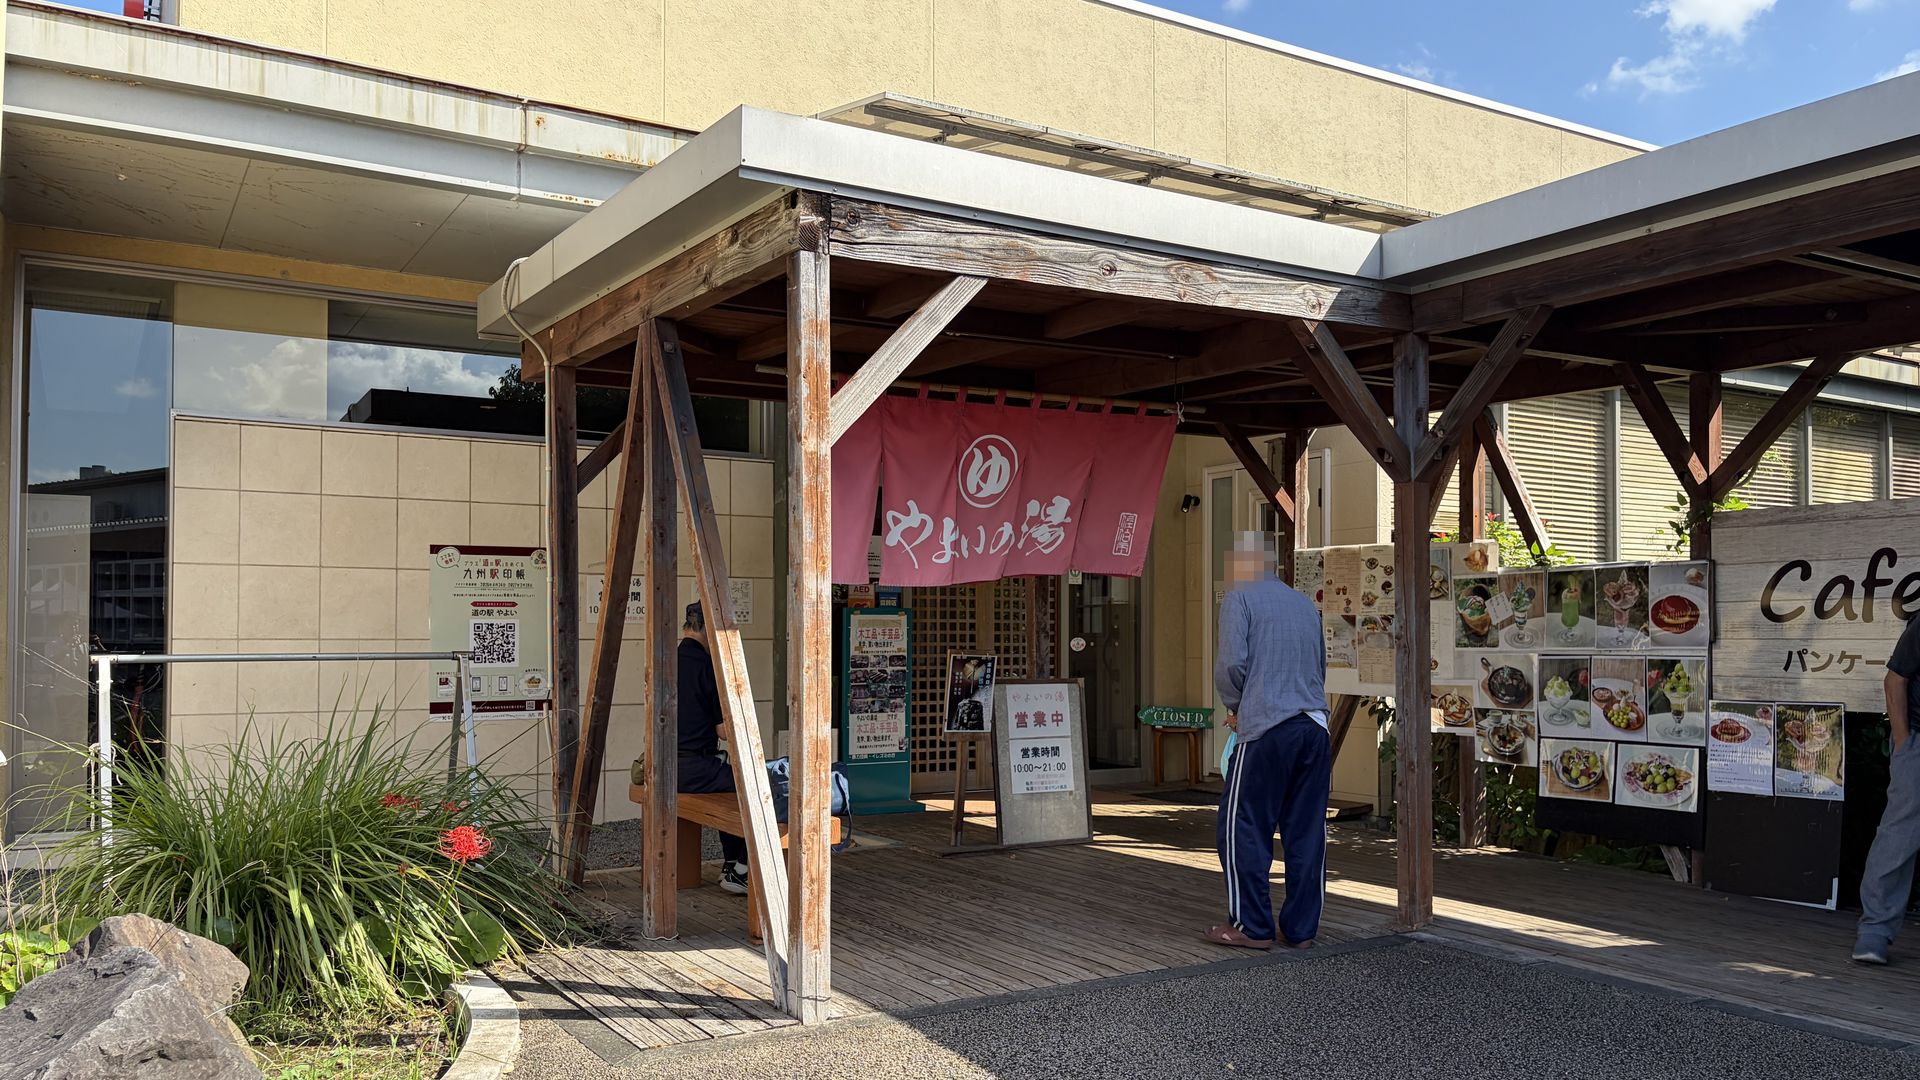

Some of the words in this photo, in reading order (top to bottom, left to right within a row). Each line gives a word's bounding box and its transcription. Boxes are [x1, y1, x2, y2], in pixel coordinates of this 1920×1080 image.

[966, 444, 1011, 498] ゆ
[885, 495, 1072, 569] やよいの湯
[463, 568, 525, 580] 九州駅印帳
[853, 585, 870, 593] AED
[471, 609, 494, 617] 道の駅
[496, 609, 518, 617] やよい
[858, 628, 900, 640] 木工品・手芸品
[1782, 648, 1893, 675] パンケー
[1012, 691, 1065, 703] やよいの湯
[1014, 710, 1064, 729] 営業中
[1153, 711, 1204, 723] CLOSED
[856, 721, 898, 735] 木工品・手芸品
[1020, 746, 1060, 759] 営業時間
